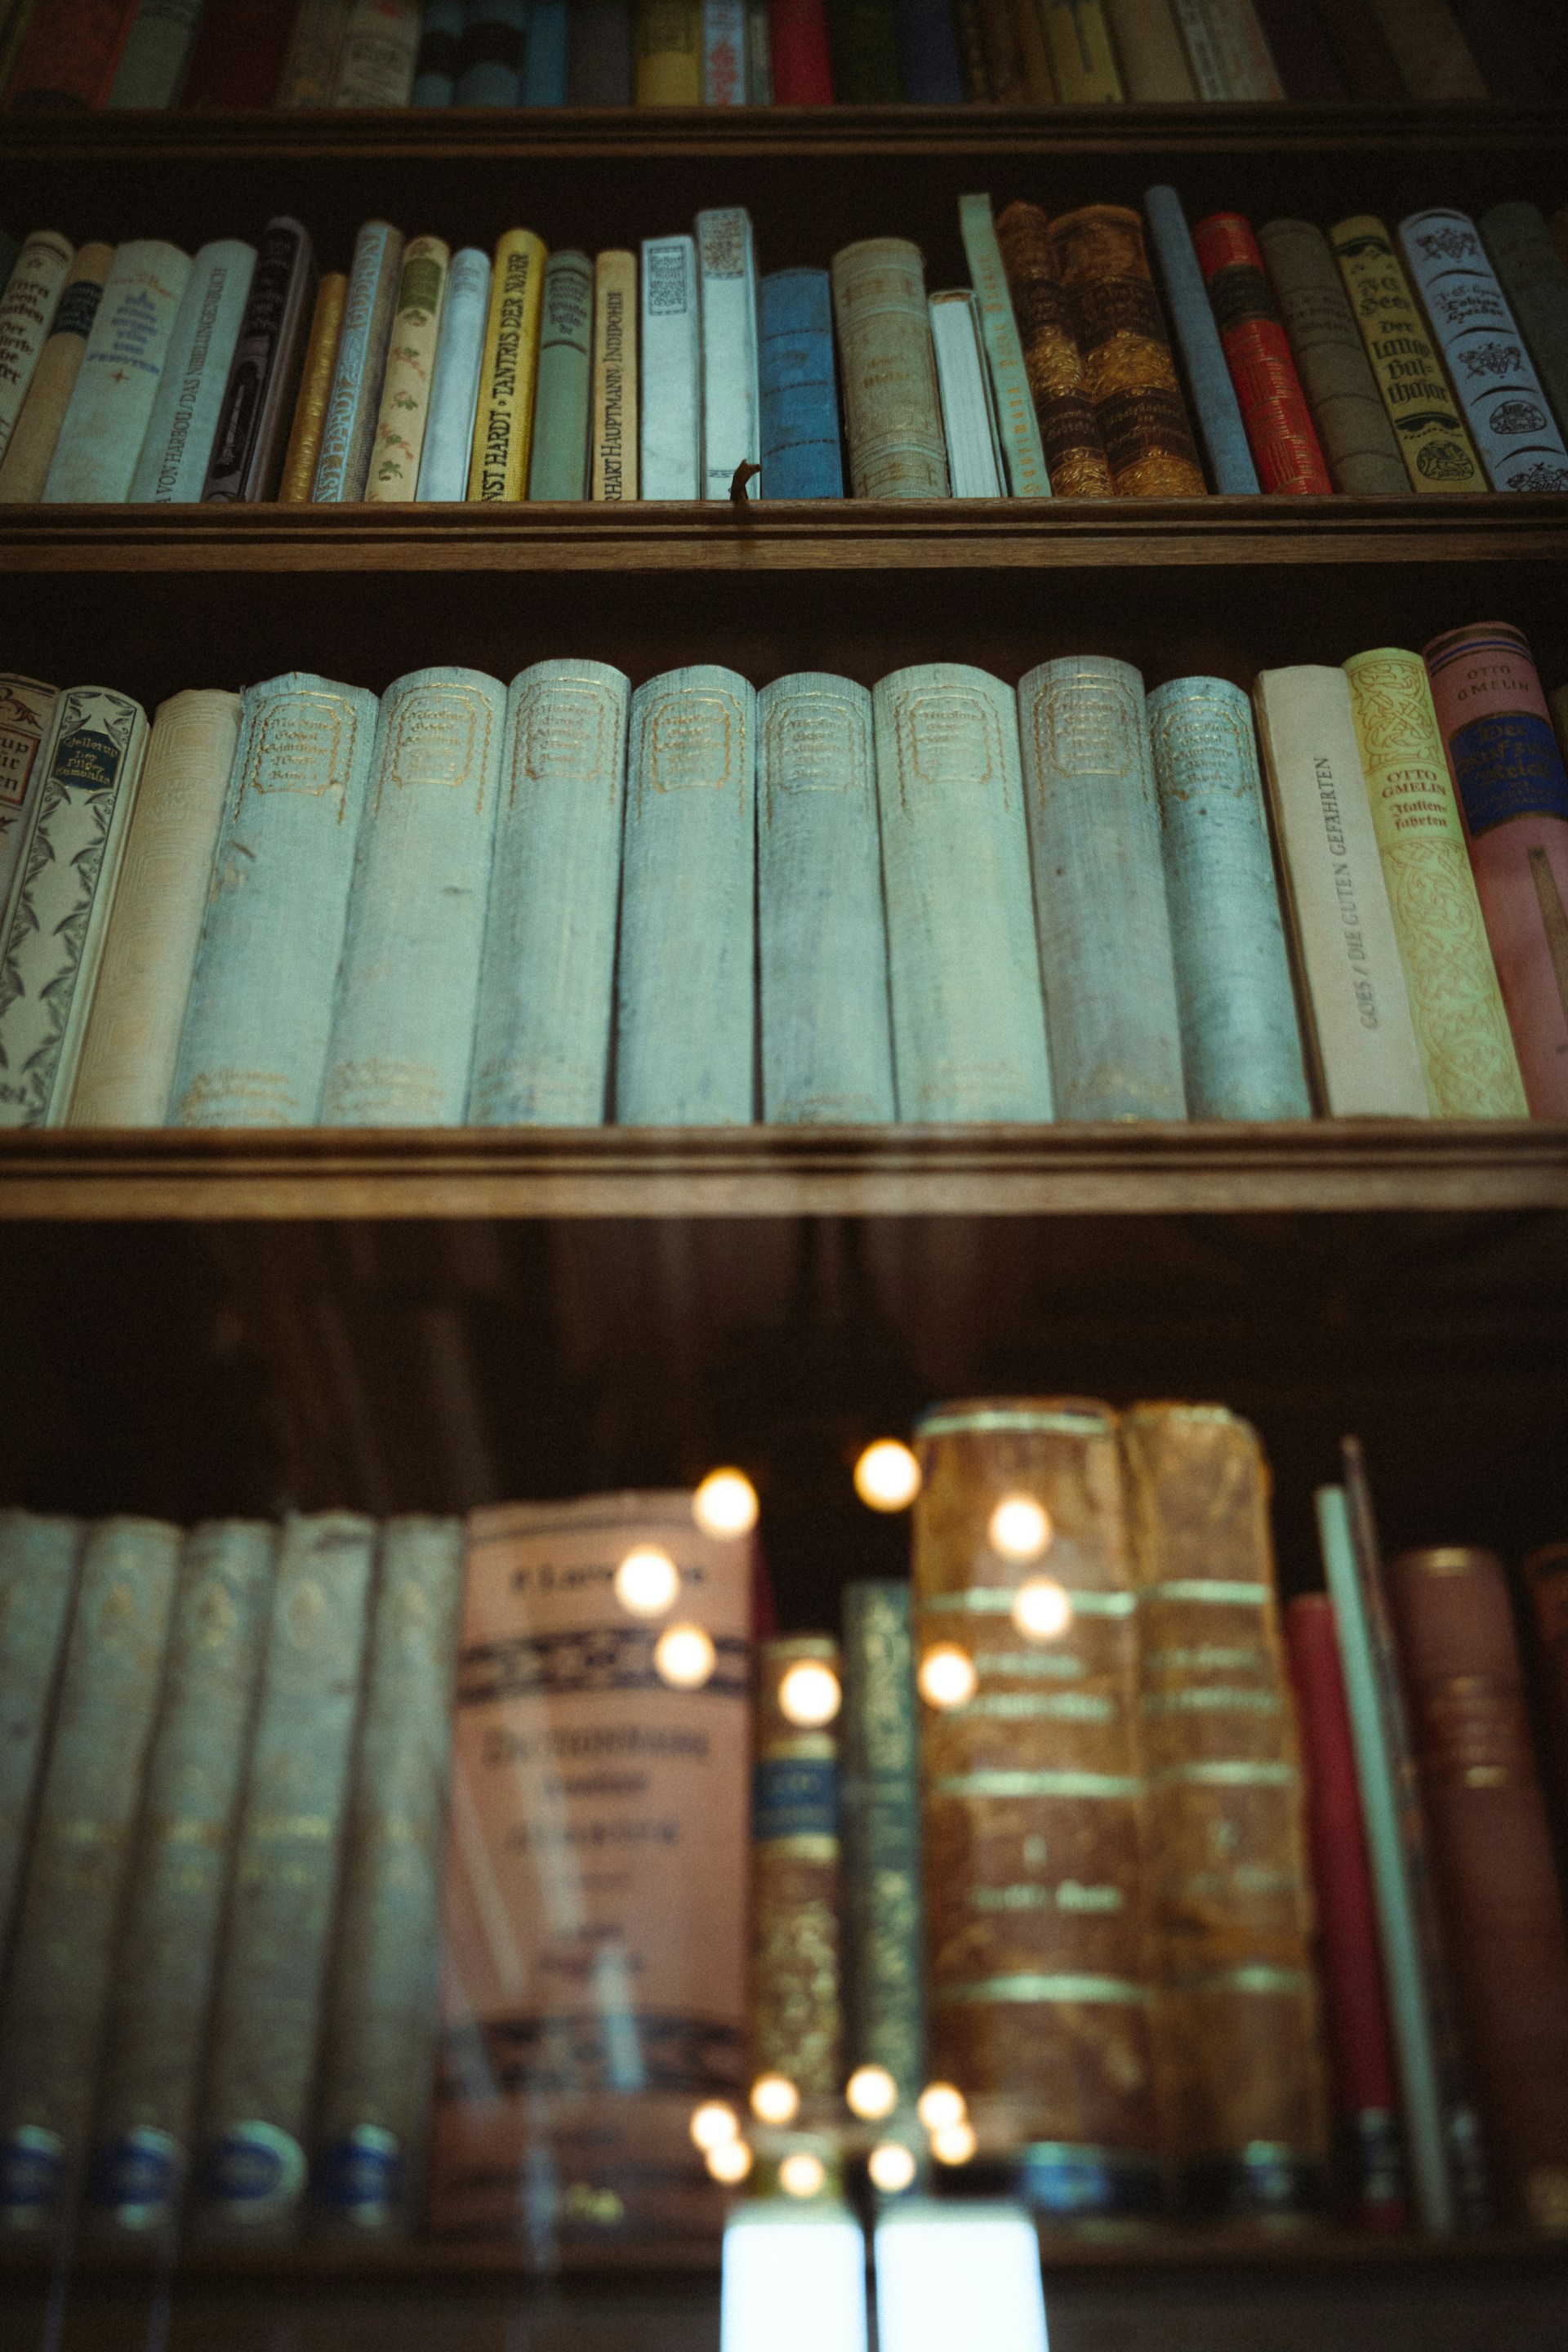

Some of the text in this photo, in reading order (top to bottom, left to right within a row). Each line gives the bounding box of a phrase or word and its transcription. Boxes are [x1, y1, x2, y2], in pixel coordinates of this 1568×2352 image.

[504, 252, 529, 295] NARR
[187, 266, 228, 376] NIBELUNGENBUCH
[501, 297, 523, 329] DER
[491, 331, 521, 400] TANTRIS
[180, 376, 202, 404] DAS
[165, 408, 193, 466] HARBOU
[483, 410, 512, 466] HARDT
[156, 465, 177, 499] VON
[1467, 665, 1511, 679] OTTO
[1457, 679, 1530, 701] GMELIN
[1381, 782, 1447, 799] GMELIN
[1387, 769, 1437, 783] OTTO
[1333, 862, 1358, 927] GUTEN
[1343, 931, 1366, 961] DIE
[1352, 981, 1379, 1030] GOES
